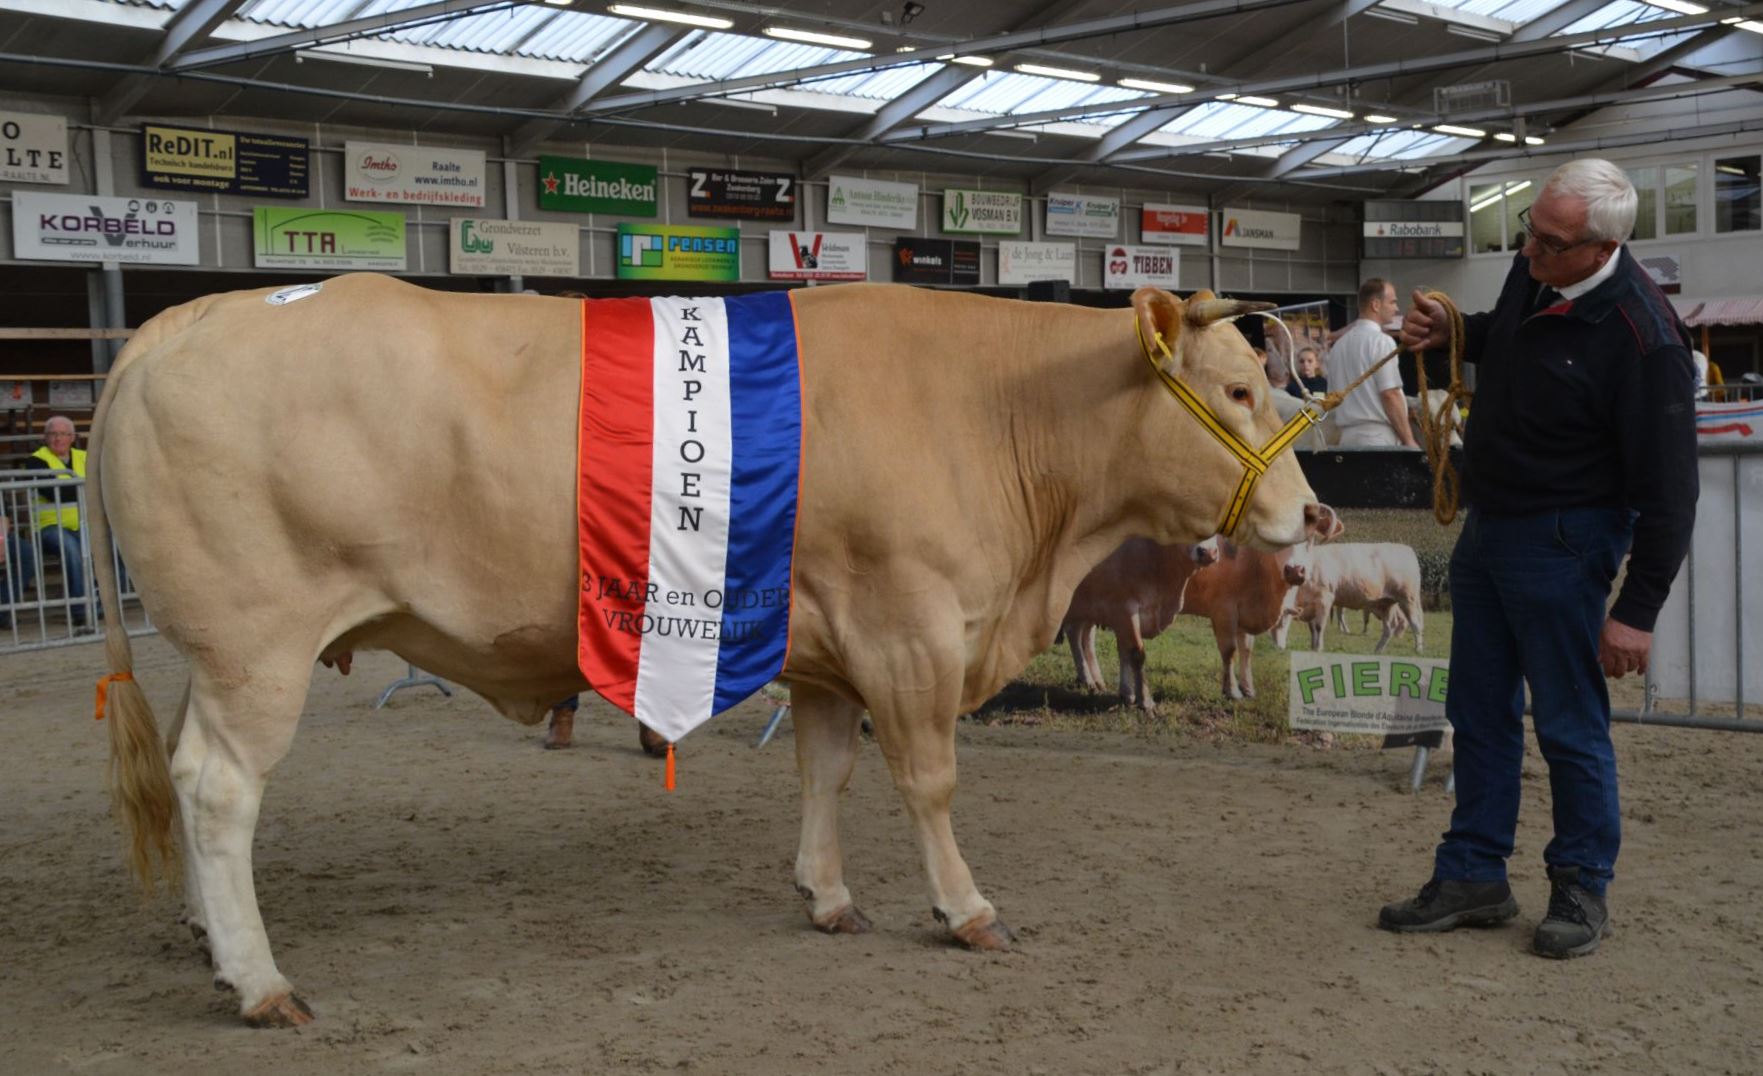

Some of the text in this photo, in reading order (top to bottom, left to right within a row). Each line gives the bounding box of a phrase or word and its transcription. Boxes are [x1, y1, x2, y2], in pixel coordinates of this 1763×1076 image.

[149, 133, 232, 160] ReDIT.nl
[361, 155, 398, 171] Imtho
[432, 161, 461, 172] Raalte
[153, 174, 170, 184] ook
[171, 176, 192, 185] voor
[193, 178, 229, 189] montage
[414, 175, 478, 187] www.imtho.nl
[564, 173, 655, 202] Heineken
[349, 187, 482, 206] Werk- en bedrijfskleding
[971, 207, 1005, 221] VOSMAN
[40, 213, 176, 236] KORBELD
[480, 220, 541, 236] Grondverzet
[1390, 224, 1442, 236] Rabobank
[283, 231, 336, 254] TTA
[668, 235, 737, 254] rensen
[1133, 255, 1173, 275] TIBBEN
[676, 307, 707, 532] KAMPIOEN
[582, 573, 592, 592] 3
[597, 575, 659, 603] JAAR
[666, 590, 696, 606] en
[1297, 661, 1450, 704] FIERE
[1302, 706, 1315, 716] The
[1316, 708, 1349, 719] European
[1350, 710, 1374, 720] Blonde
